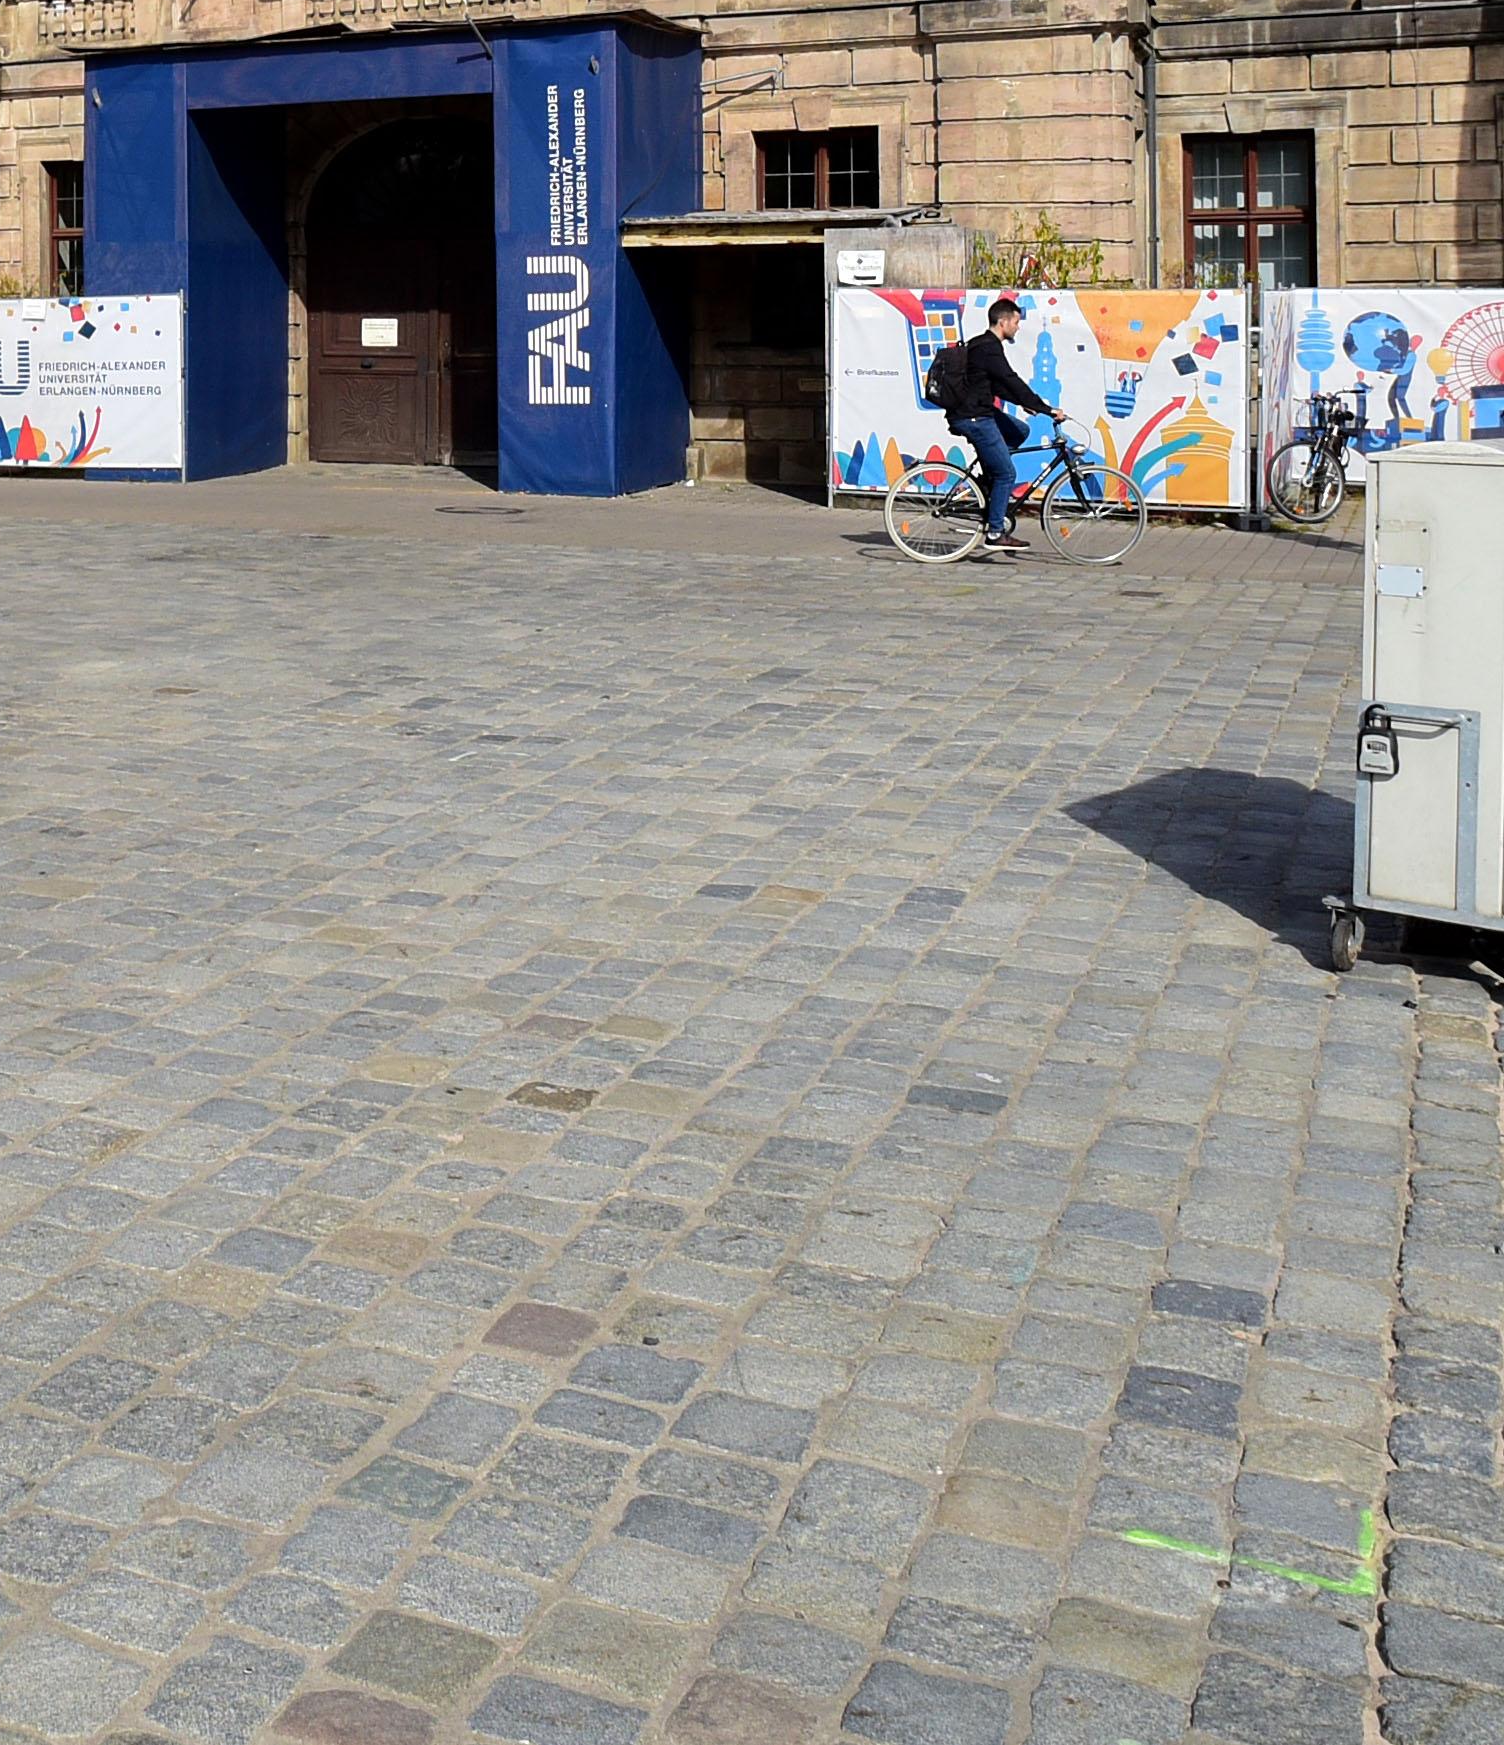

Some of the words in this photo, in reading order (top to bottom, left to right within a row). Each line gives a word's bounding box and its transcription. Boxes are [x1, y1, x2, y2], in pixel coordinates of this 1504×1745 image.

[547, 84, 561, 247] FRIEDRICH-ALEXANDER
[561, 157, 575, 247] UNIVERSITÄT
[572, 88, 588, 246] ERLANGEN-NÜRNBERG
[38, 360, 167, 372] FRIEDRICH-ALEXANDER
[526, 255, 591, 405] FAU
[38, 372, 108, 384] UNIVERSITÄT
[39, 383, 163, 396] ERLANGEN-NÜRNBERG
